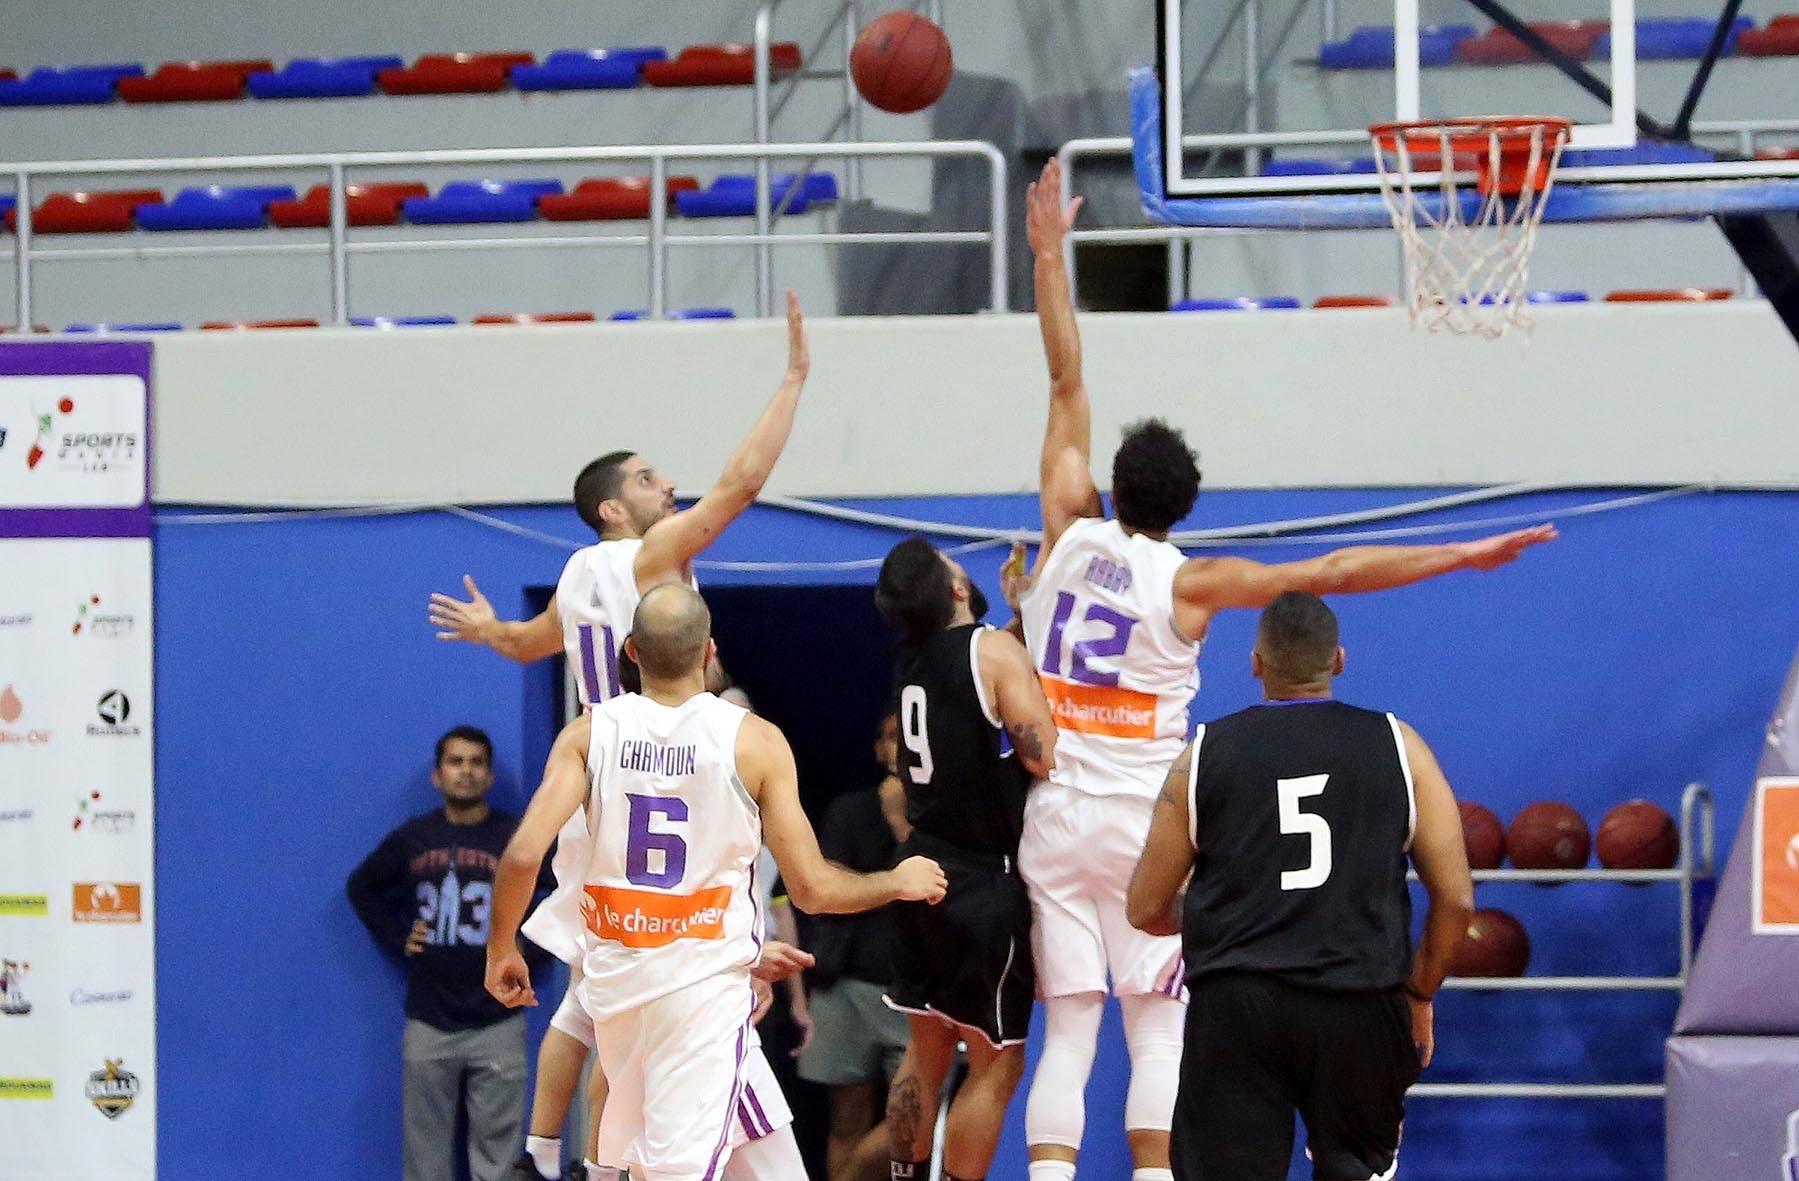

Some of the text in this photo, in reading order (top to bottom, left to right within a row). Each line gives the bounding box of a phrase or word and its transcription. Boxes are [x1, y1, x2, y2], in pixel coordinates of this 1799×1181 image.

[62, 433, 137, 448] SPORTS
[1041, 590, 1140, 688] 12
[901, 684, 934, 785] 9
[1056, 697, 1153, 727] charcutier
[620, 739, 697, 777] CHAMOUN
[624, 793, 689, 890] 6
[1276, 773, 1333, 891] 5
[604, 904, 620, 930] le
